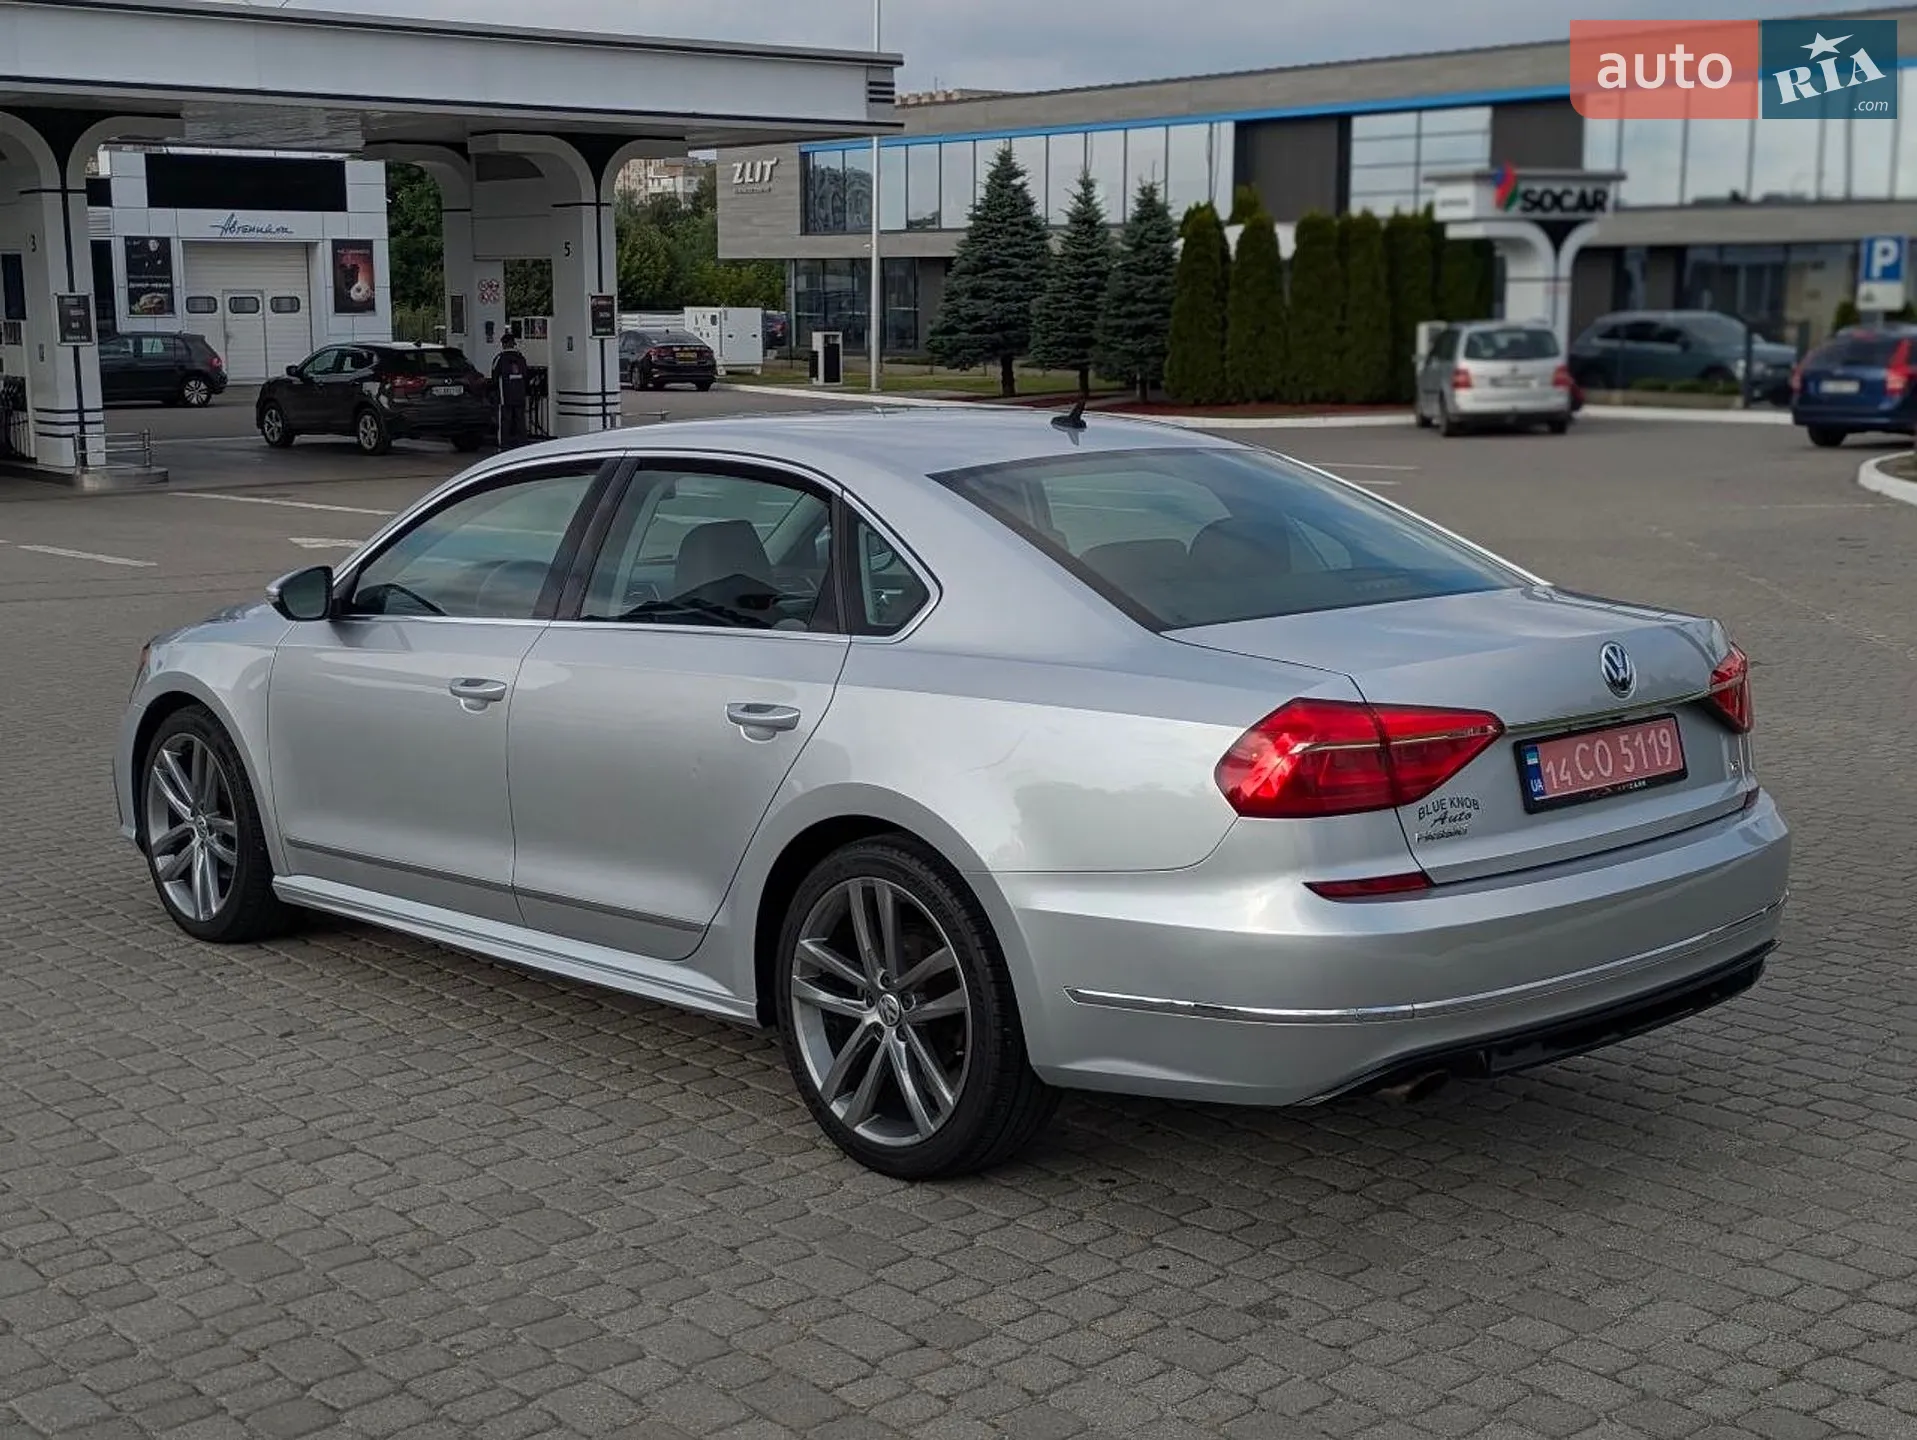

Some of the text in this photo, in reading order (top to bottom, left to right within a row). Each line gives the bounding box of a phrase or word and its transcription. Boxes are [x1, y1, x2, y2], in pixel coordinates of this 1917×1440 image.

[732, 157, 779, 184] ZLIT
[1521, 188, 1609, 213] SOCAR
[564, 241, 571, 257] 5
[1871, 239, 1900, 279] P
[1617, 728, 1672, 774] 5119
[1530, 778, 1544, 793] UA
[1418, 797, 1480, 820] BLUE KNOB
[1430, 810, 1472, 827] Auto
